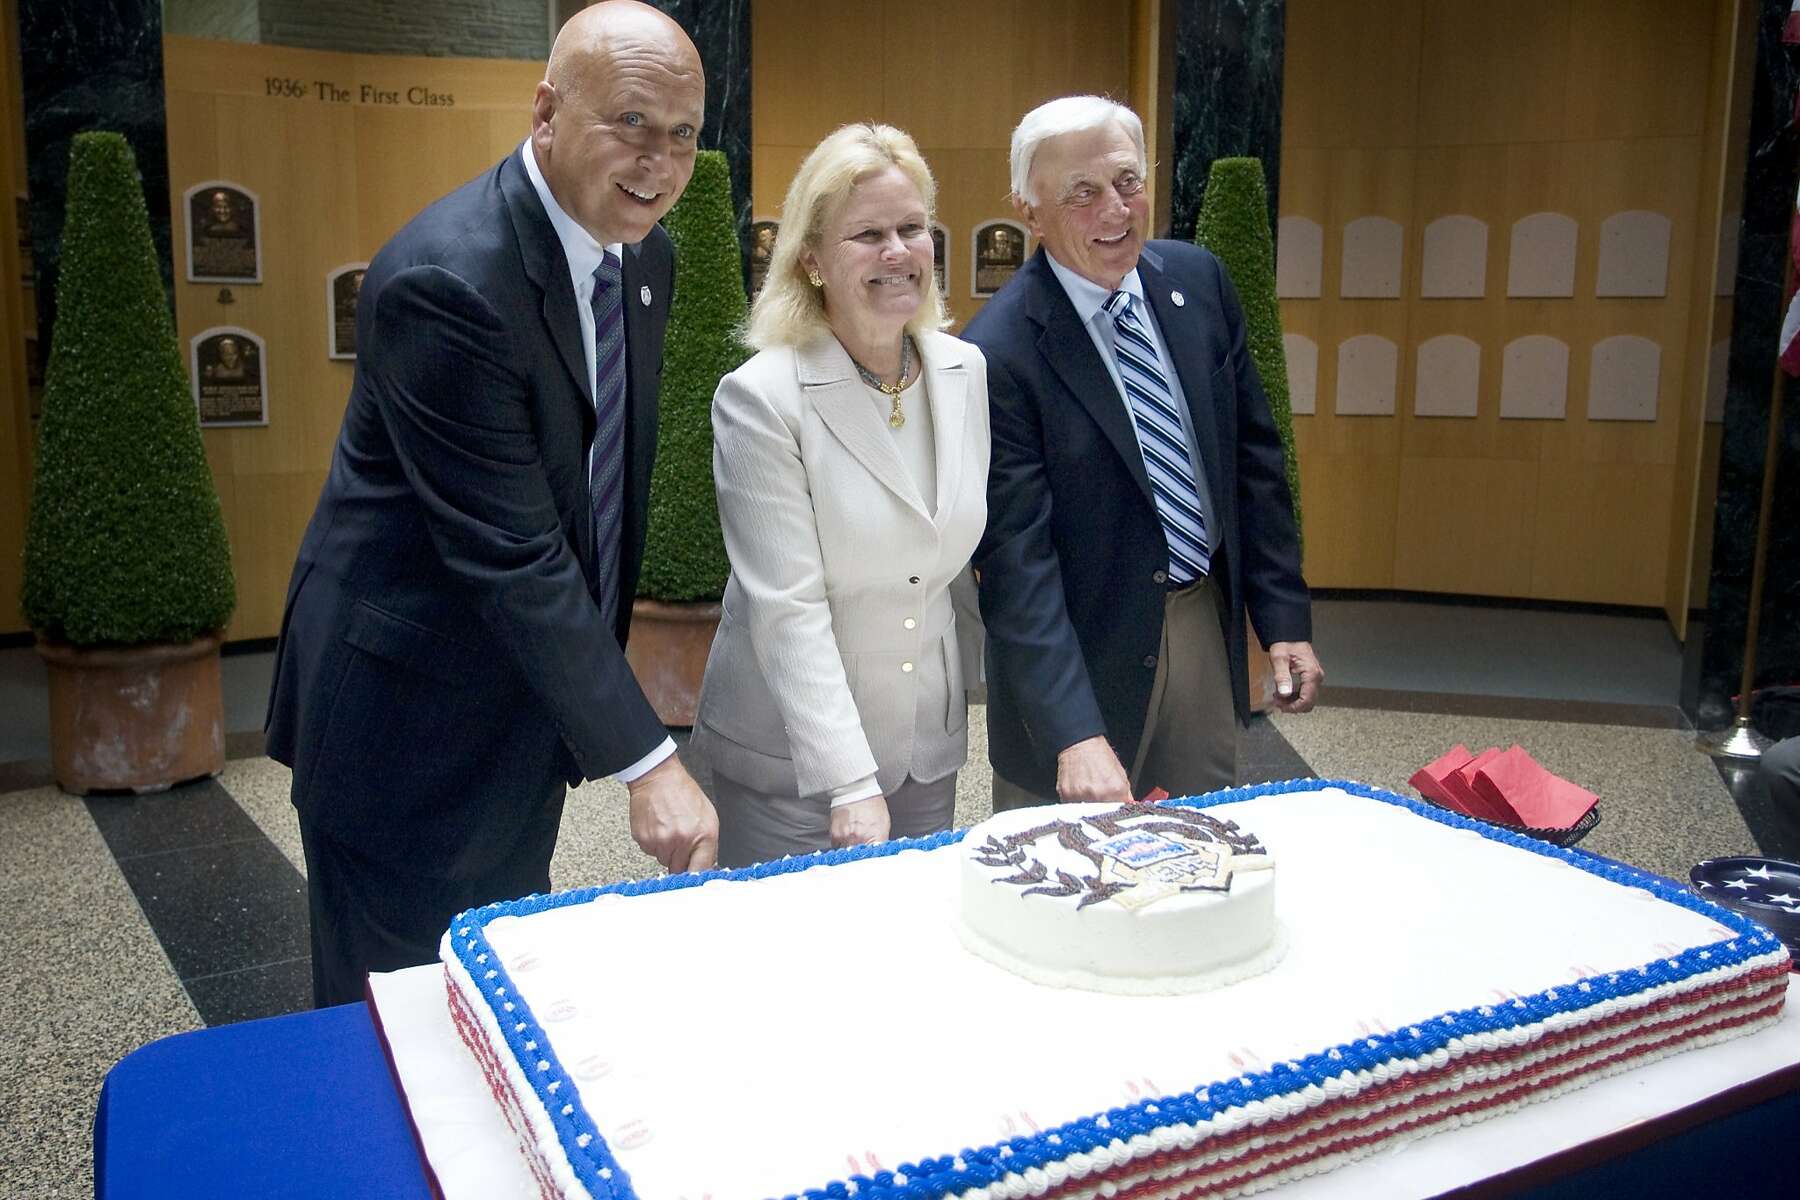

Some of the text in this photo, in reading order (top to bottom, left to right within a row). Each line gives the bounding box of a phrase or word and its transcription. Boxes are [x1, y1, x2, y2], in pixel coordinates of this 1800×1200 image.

[312, 80, 351, 102] The
[360, 84, 399, 105] First
[407, 86, 455, 106] Class
